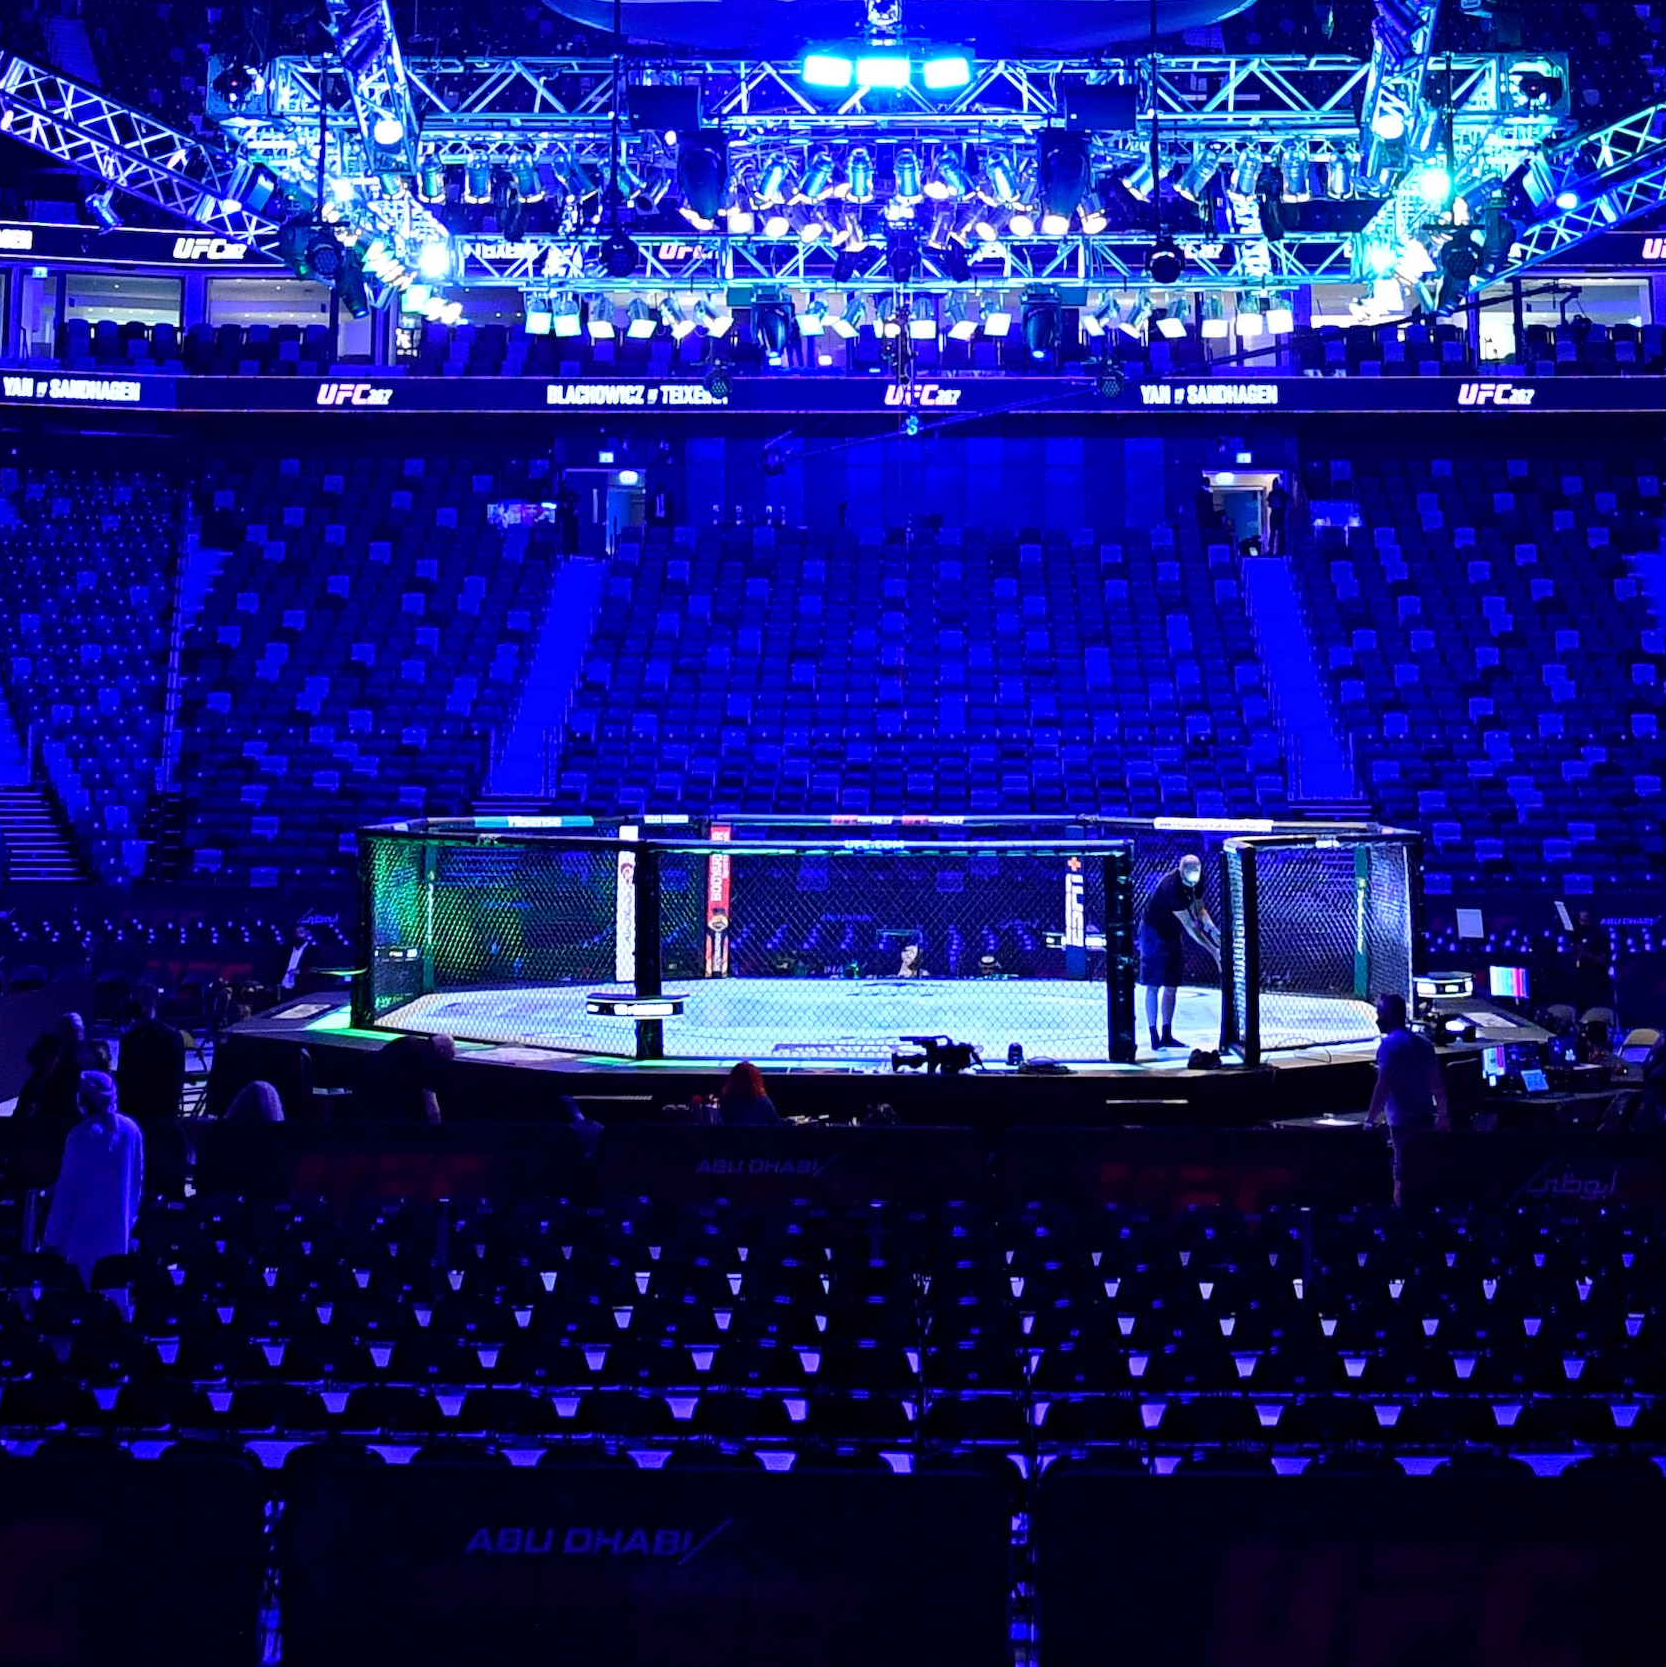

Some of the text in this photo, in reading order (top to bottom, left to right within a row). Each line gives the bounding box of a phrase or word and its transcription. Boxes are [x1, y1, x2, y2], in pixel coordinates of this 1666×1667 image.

[172, 237, 226, 260] UFC
[3, 377, 33, 397] YAN
[49, 379, 141, 402] SANDHAGEN
[316, 383, 372, 405] UFC
[547, 385, 645, 405] BLACHOWICZ
[1140, 385, 1171, 405] YAN
[1187, 384, 1278, 405] SANDHAGEN
[1457, 383, 1513, 405] UFC
[695, 1159, 819, 1175] ABU DHABI
[464, 1526, 693, 1554] ABU DHABI
